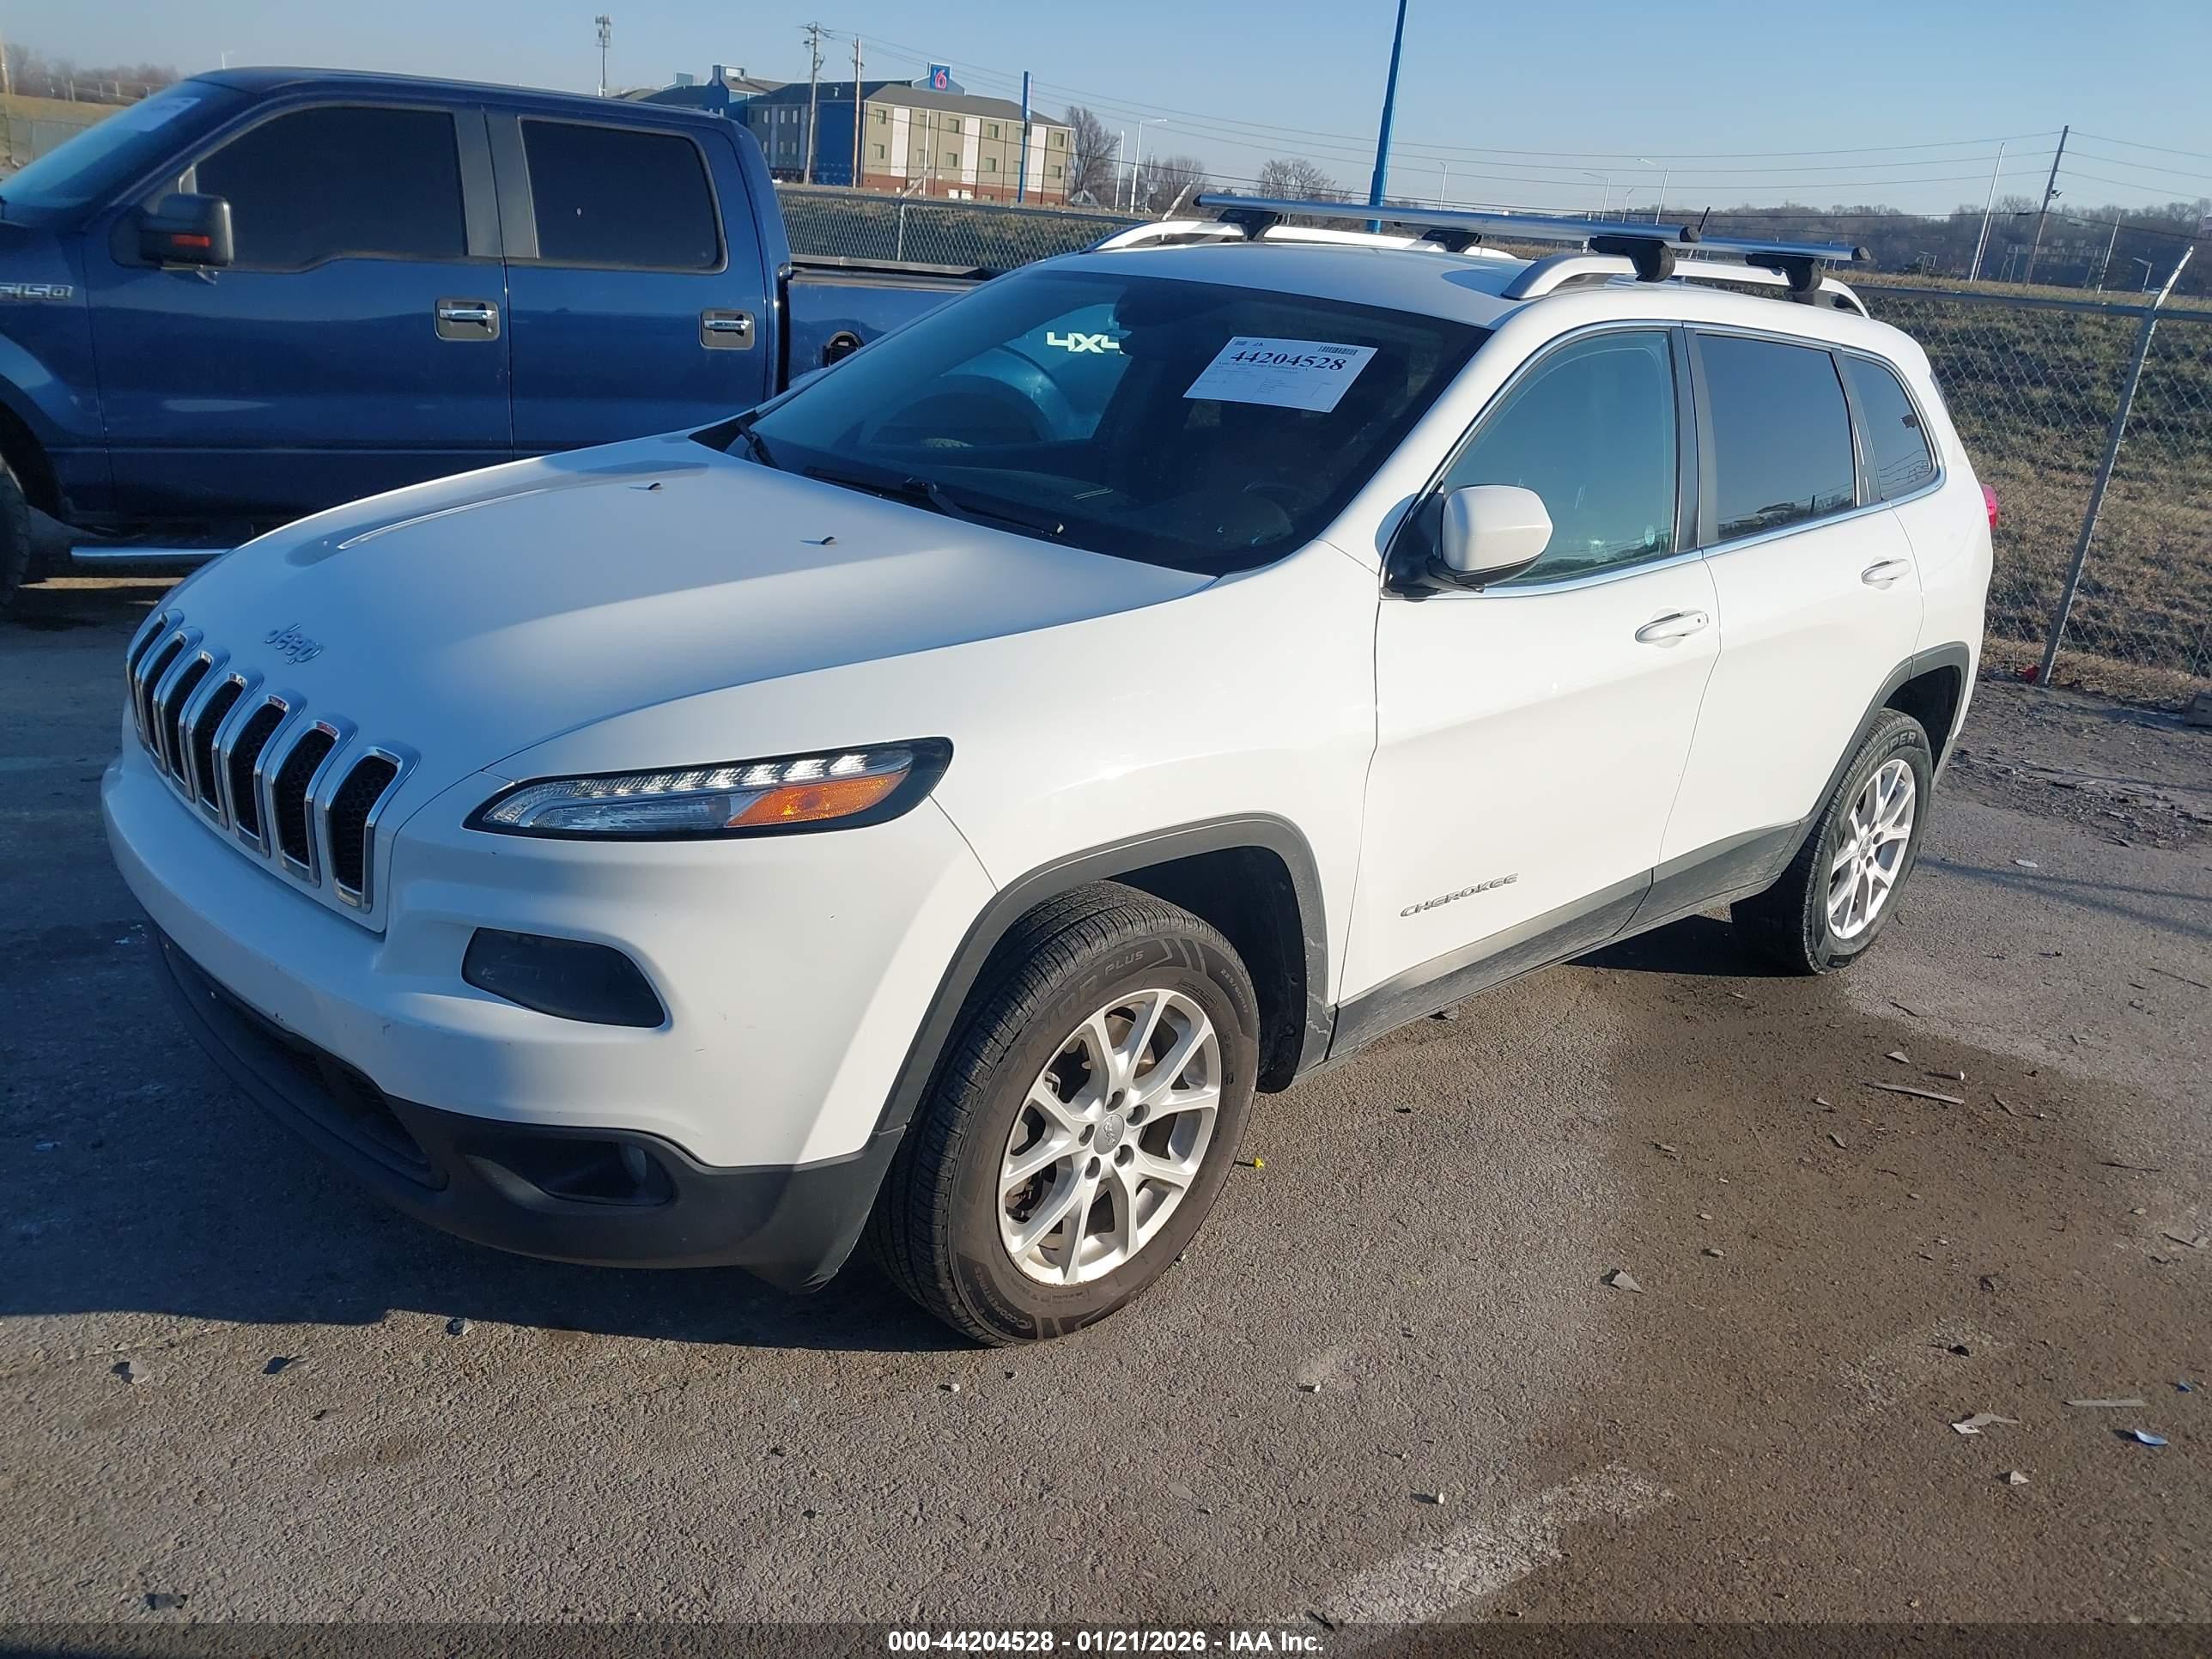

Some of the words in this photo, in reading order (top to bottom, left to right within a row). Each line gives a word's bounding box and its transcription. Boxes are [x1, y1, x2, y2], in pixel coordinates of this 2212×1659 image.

[934, 69, 947, 89] 6
[1231, 350, 1346, 371] 44204528
[264, 623, 323, 665] Jeep
[1401, 872, 1518, 916] CHEROKEE
[1104, 951, 1145, 976] PLUS
